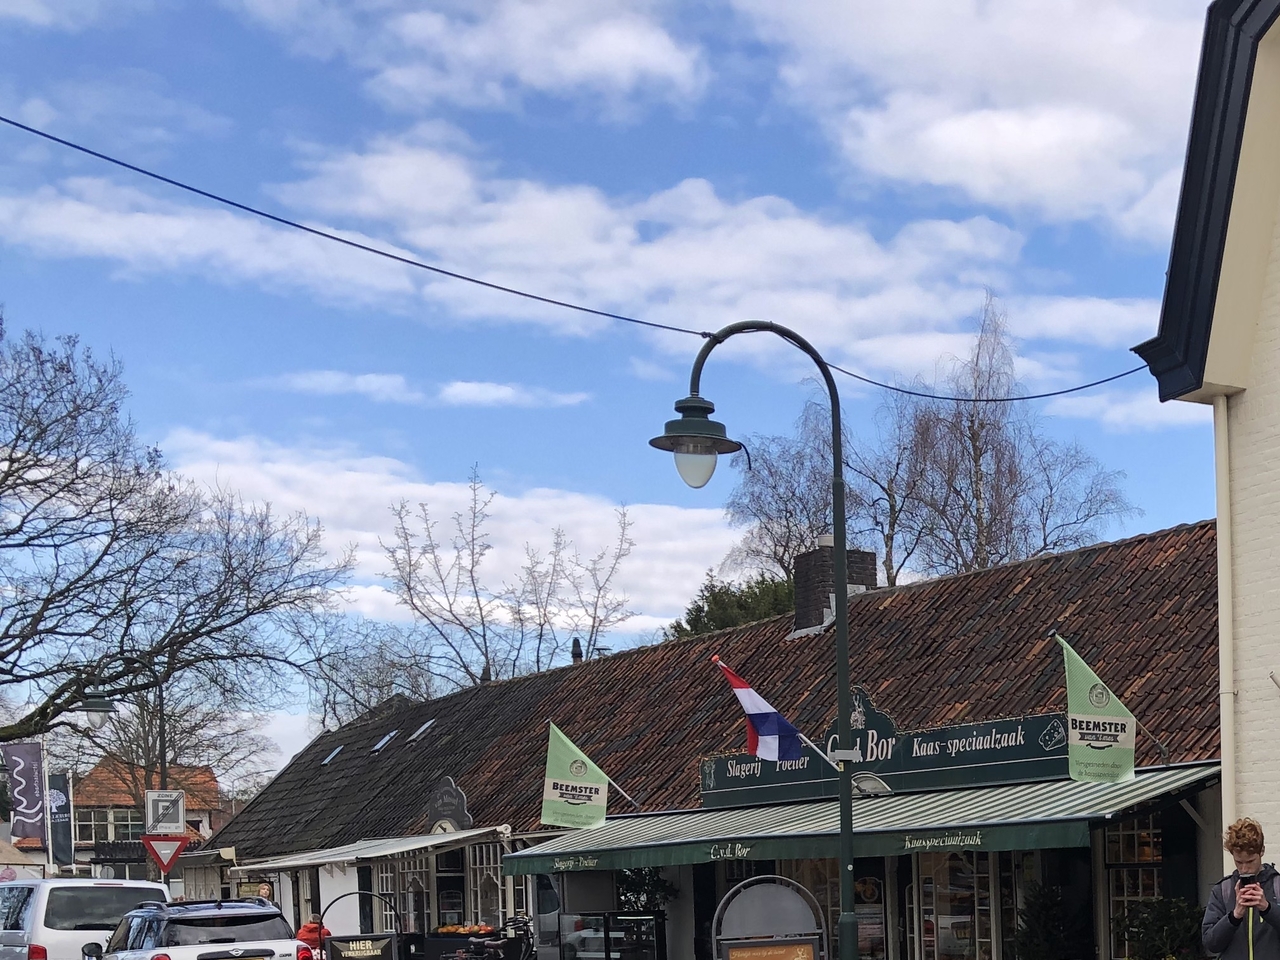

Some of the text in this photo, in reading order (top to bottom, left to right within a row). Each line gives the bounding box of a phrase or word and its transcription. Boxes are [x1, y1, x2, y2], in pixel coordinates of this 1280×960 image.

[1071, 718, 1127, 734] BEEMSTER
[865, 729, 896, 762] Bor
[912, 726, 1026, 757] Kaas-speciaalzaak
[727, 757, 762, 779] Slagerij
[552, 781, 600, 795] BEEMSTER
[904, 831, 982, 850] Kaasspeciaalzaak
[710, 843, 751, 859] C.v.d. Bor
[349, 940, 373, 951] HIER
